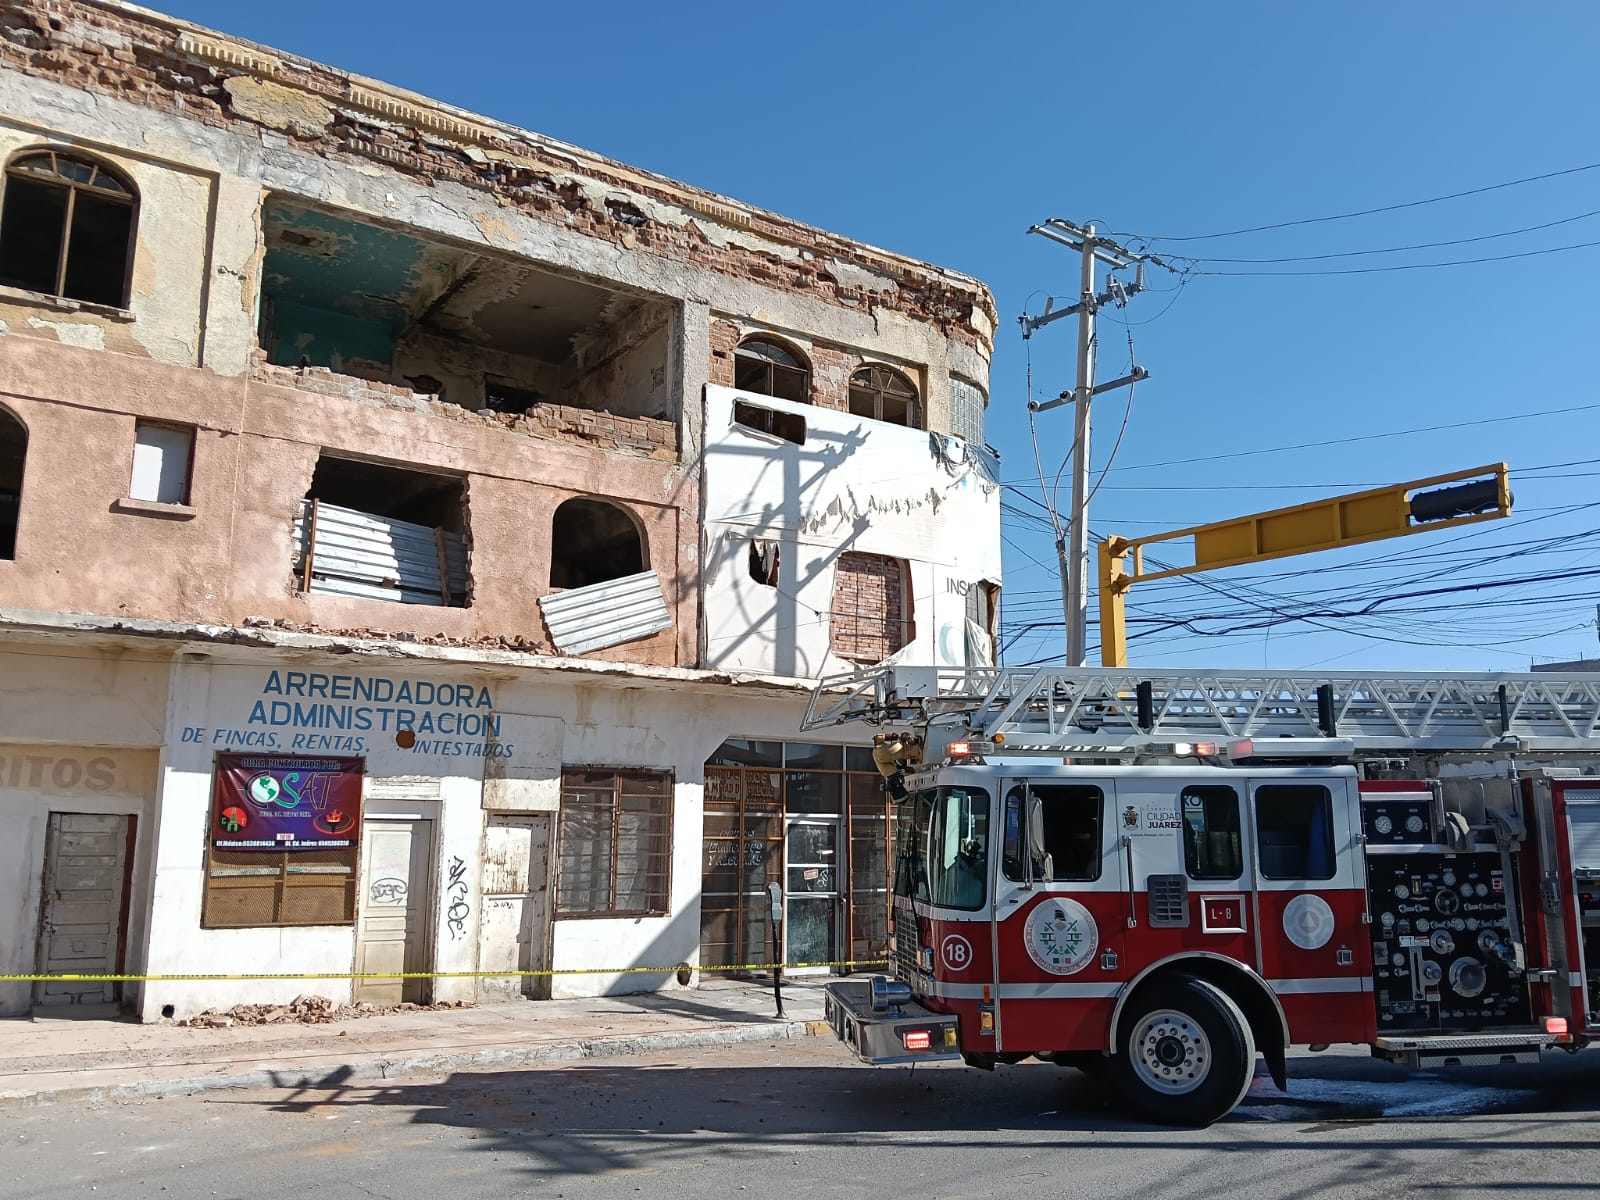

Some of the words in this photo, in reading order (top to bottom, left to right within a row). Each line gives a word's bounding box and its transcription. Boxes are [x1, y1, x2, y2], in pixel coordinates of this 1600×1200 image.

[263, 670, 493, 709] ARRENDADORA
[247, 700, 502, 737] ADMINISTRACION
[181, 726, 207, 743] DE
[213, 728, 283, 750] FINCAS,
[412, 739, 514, 758] INTESTADOS
[0, 754, 117, 791] ITOS
[1146, 812, 1181, 821] CIUDAD
[946, 943, 965, 962] 18
